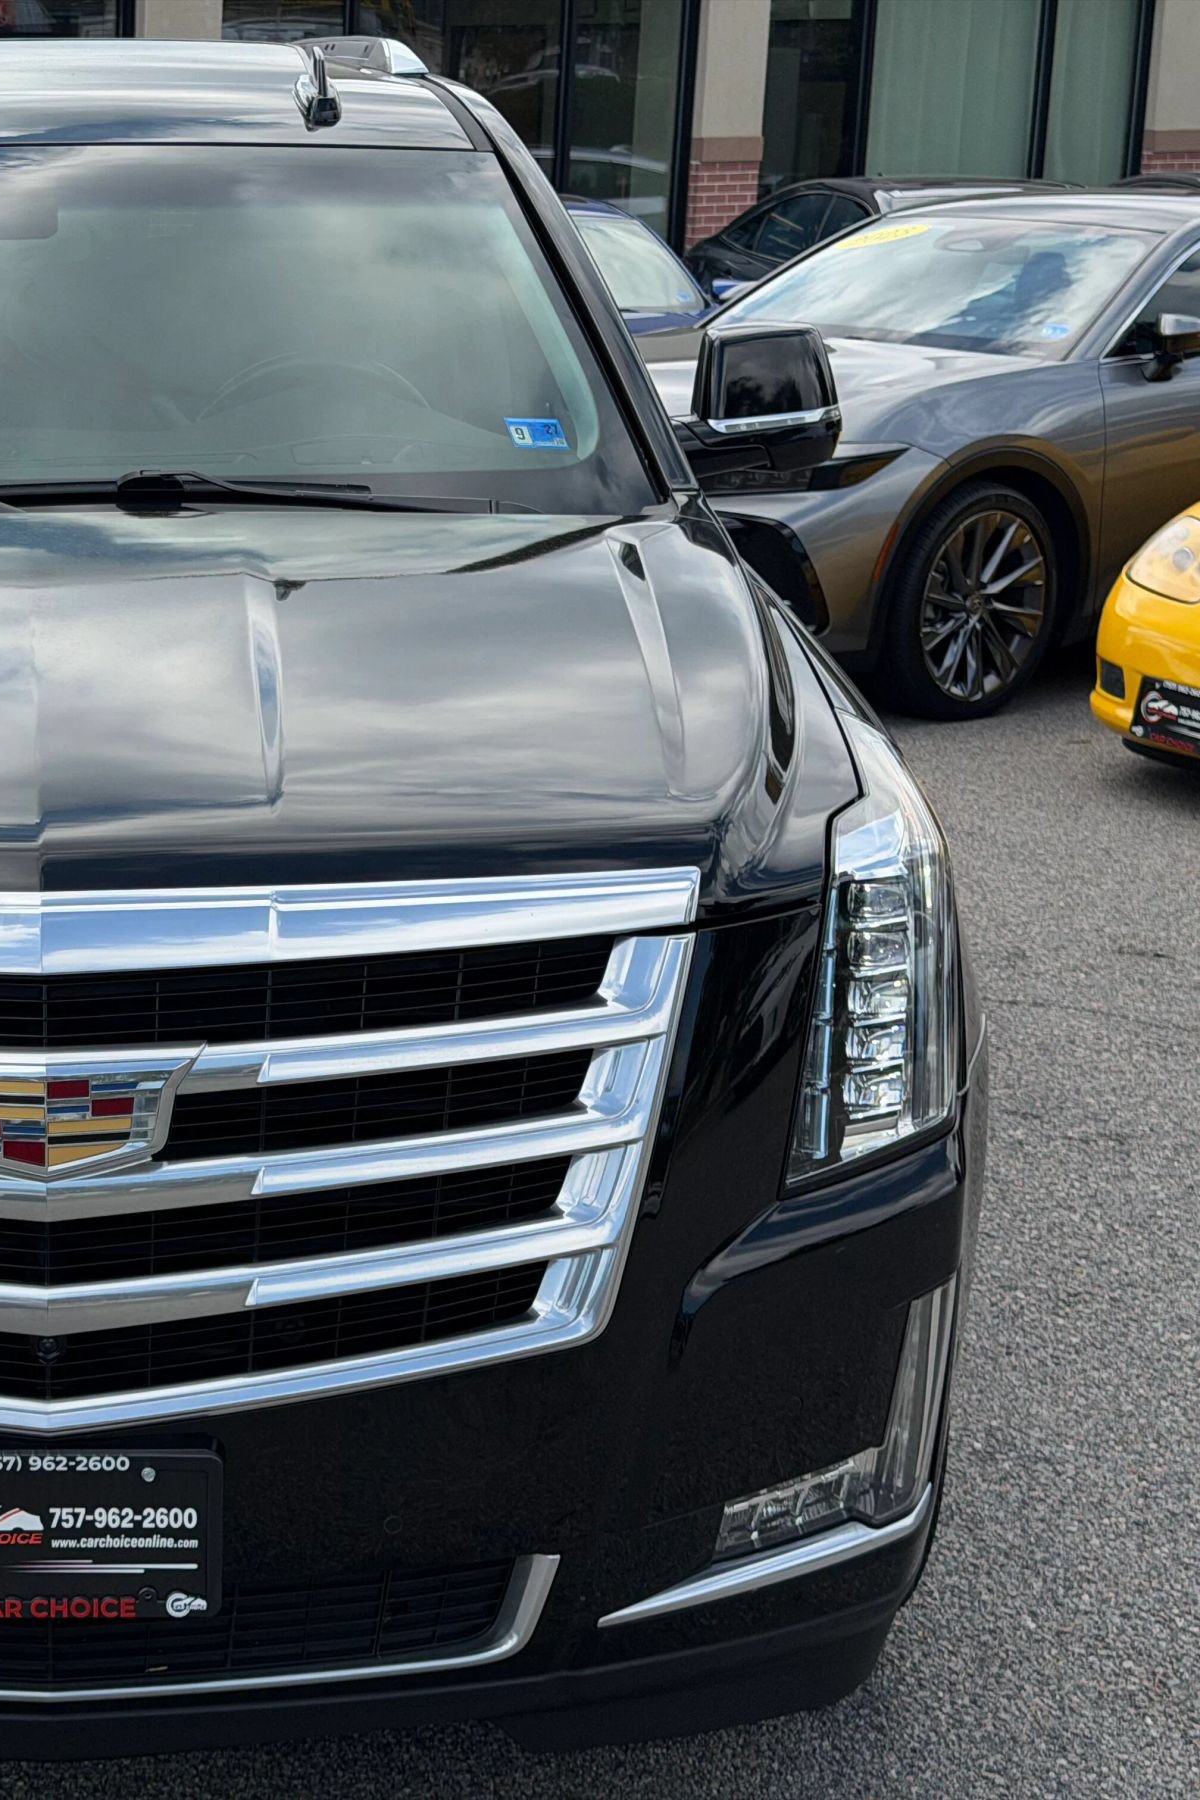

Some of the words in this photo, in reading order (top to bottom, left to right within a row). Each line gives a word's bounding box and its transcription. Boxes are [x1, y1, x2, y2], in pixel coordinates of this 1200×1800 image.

[514, 427, 526, 441] 9
[29, 1455, 130, 1472] 962-2600
[48, 1507, 198, 1529] 757-962-2600
[50, 1534, 199, 1550] www.carchoiceonline.com
[30, 1599, 137, 1618] CHOICE
